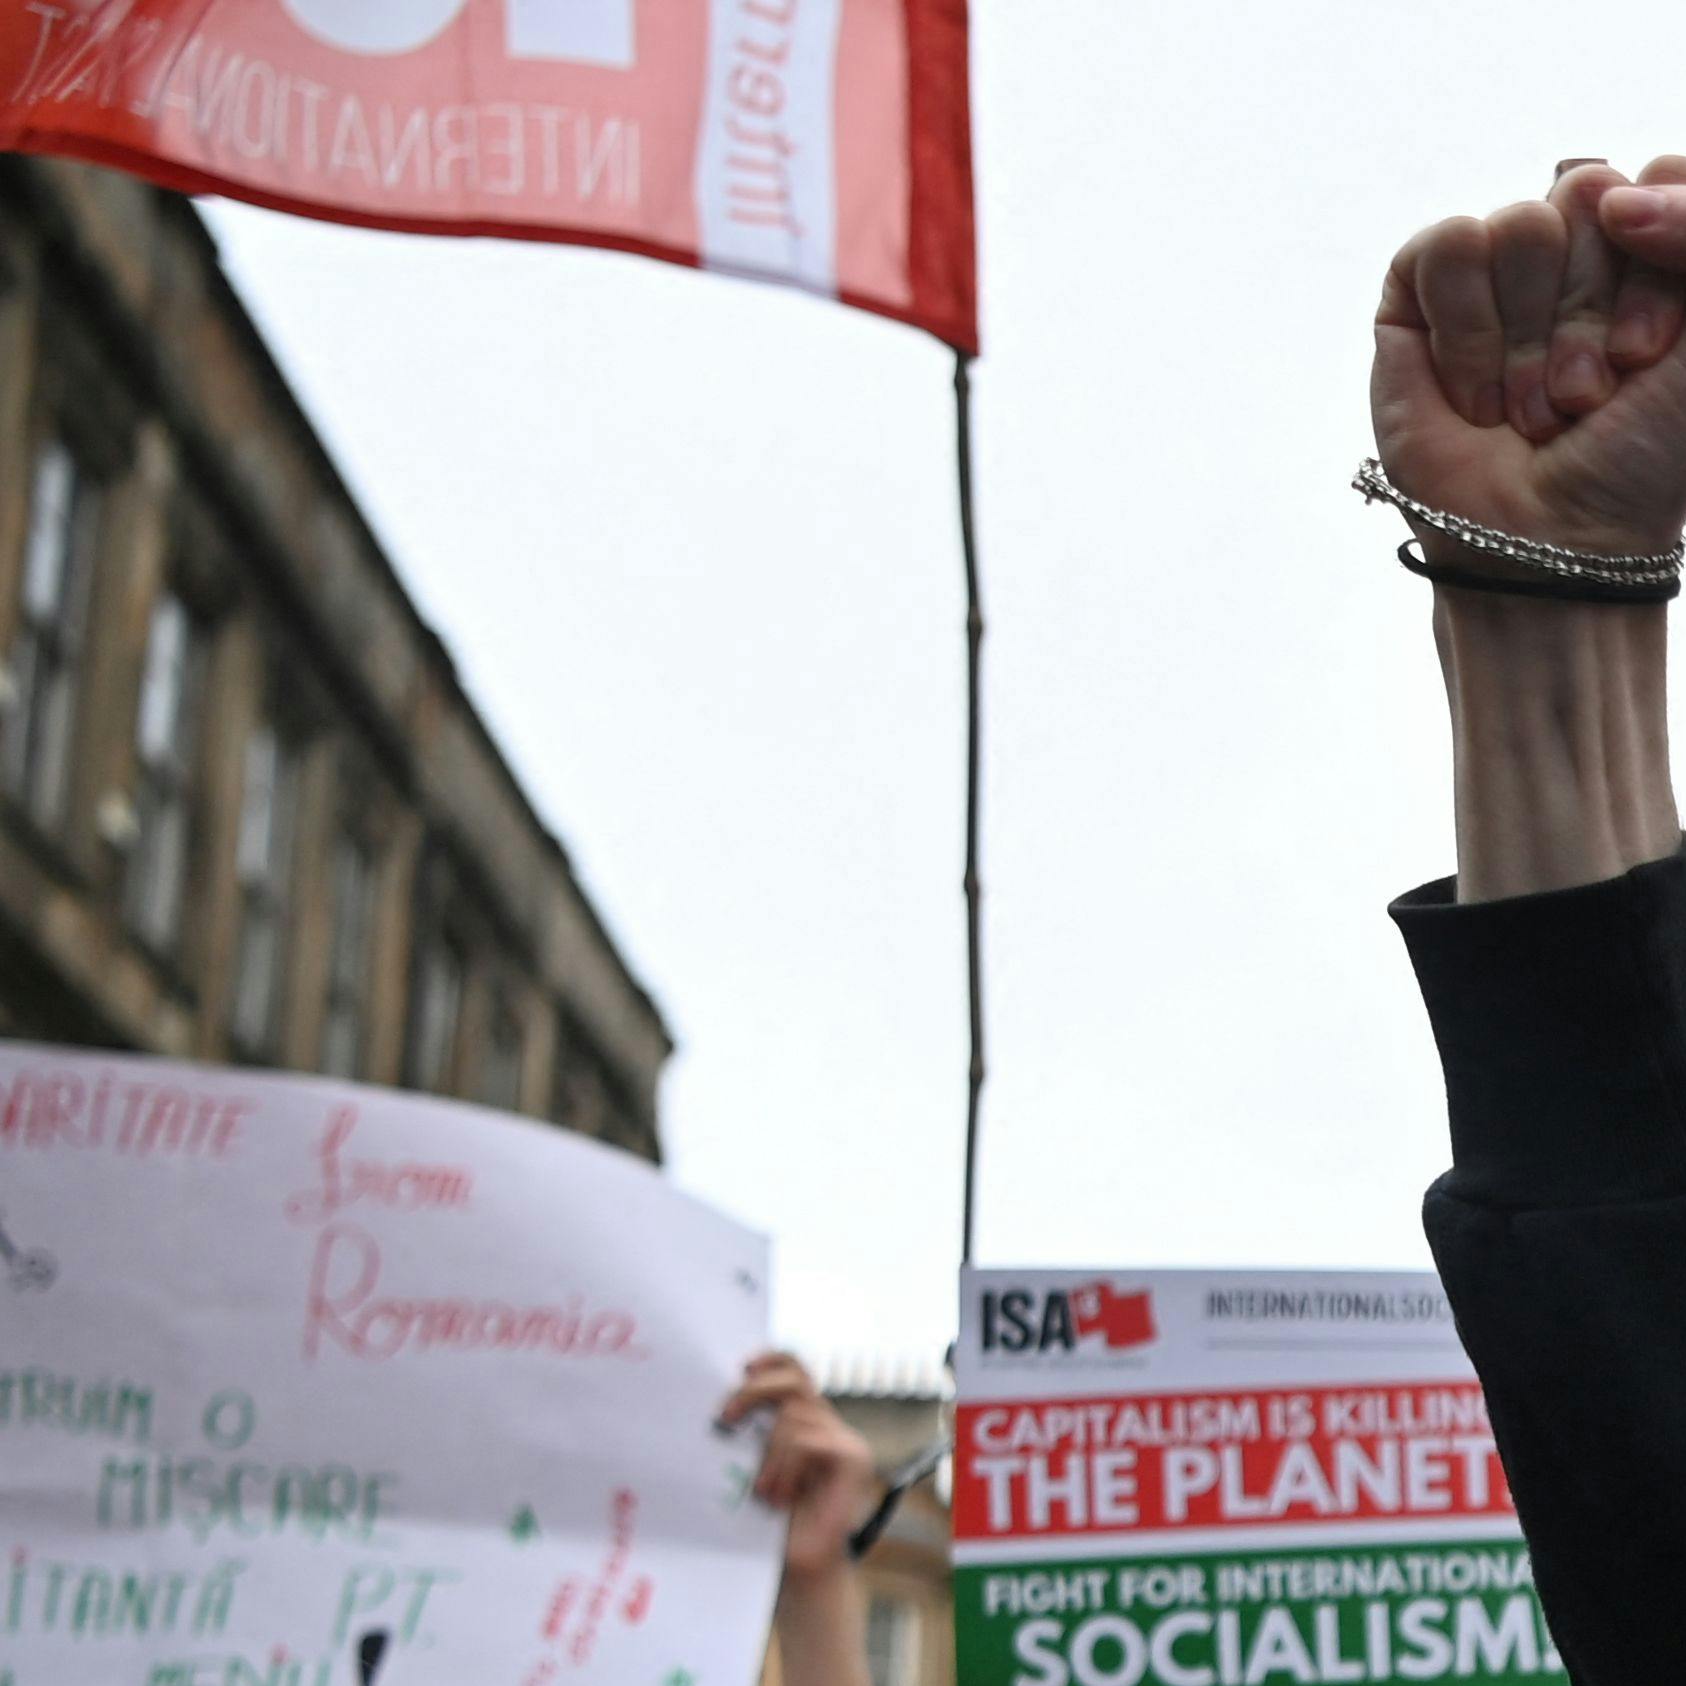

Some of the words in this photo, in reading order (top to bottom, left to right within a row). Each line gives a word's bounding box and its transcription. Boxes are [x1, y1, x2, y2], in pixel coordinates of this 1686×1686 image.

[303, 1222, 650, 1363] Romania
[980, 1288, 1077, 1353] ISA
[202, 1387, 256, 1451] O
[973, 1400, 1262, 1453] CAPITALISM
[1268, 1396, 1317, 1441] IS
[971, 1448, 1141, 1533] THE
[1160, 1434, 1512, 1523] PLANET
[984, 1563, 1112, 1616] FIGHT
[1120, 1560, 1211, 1607] FOR
